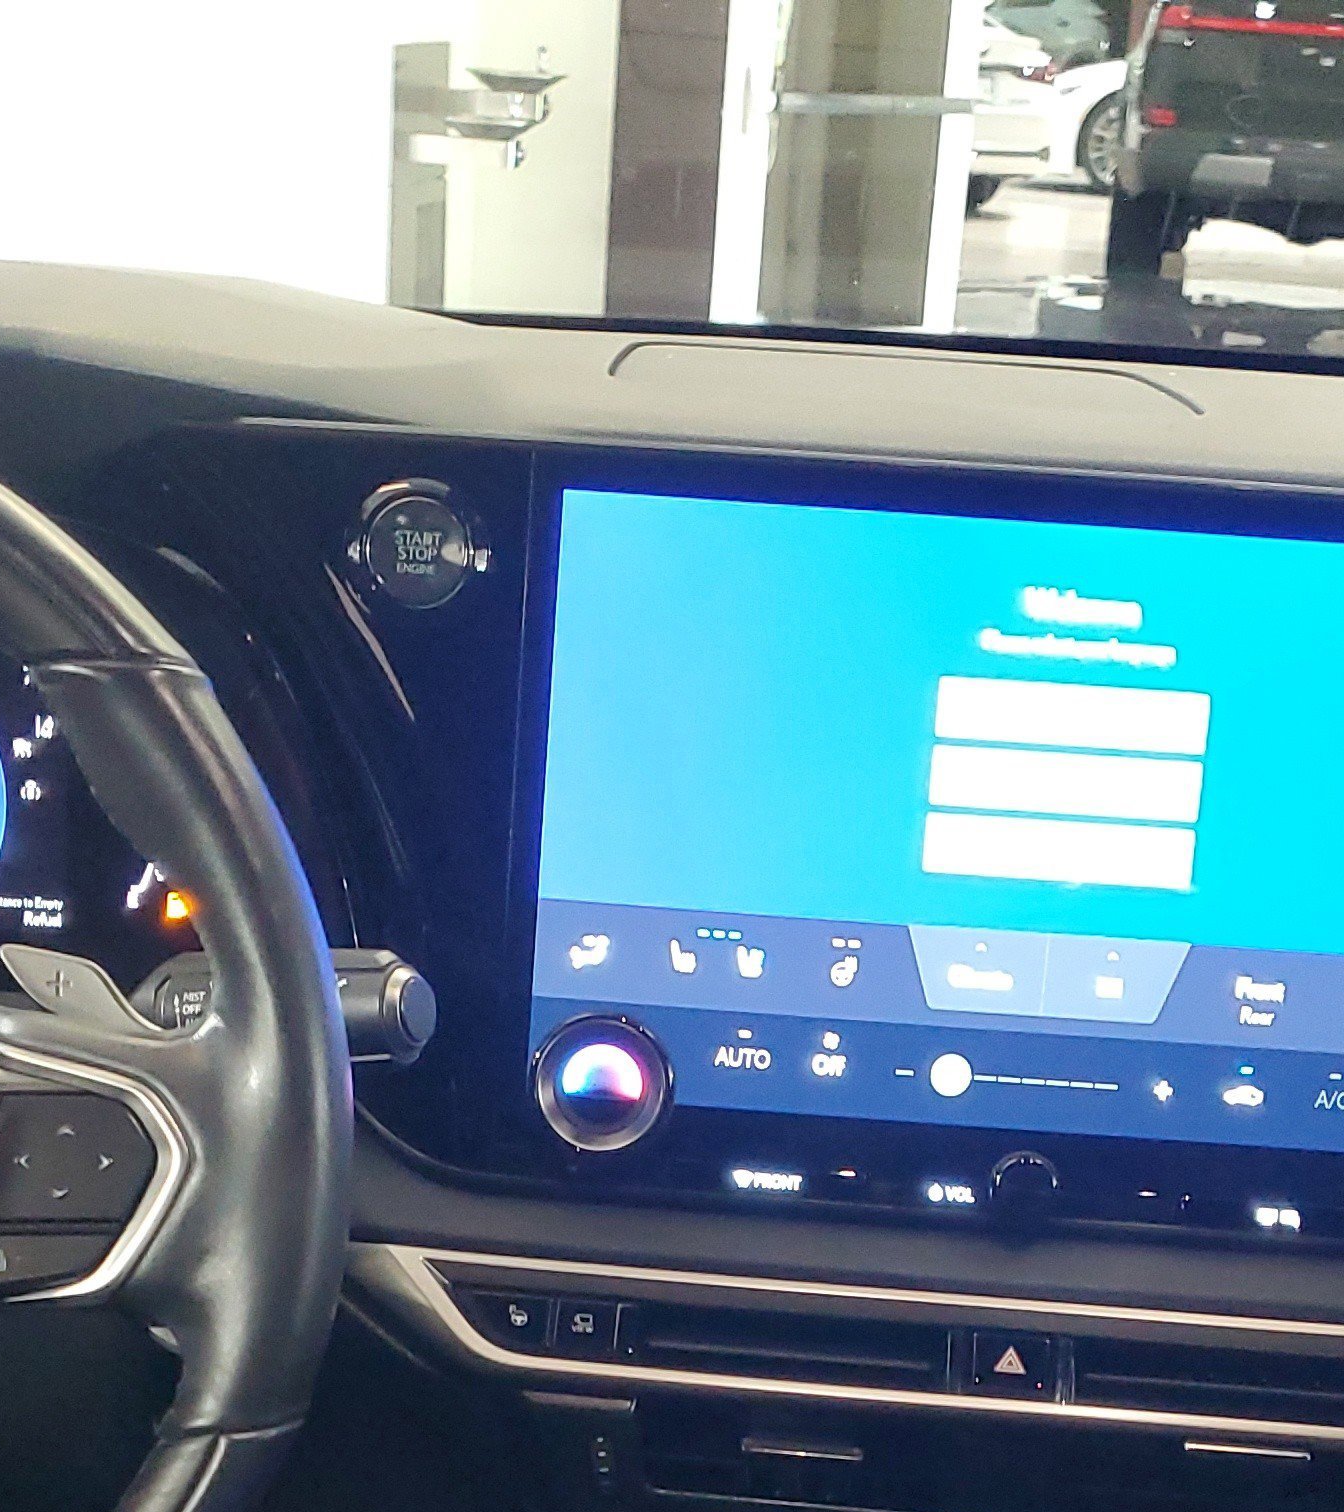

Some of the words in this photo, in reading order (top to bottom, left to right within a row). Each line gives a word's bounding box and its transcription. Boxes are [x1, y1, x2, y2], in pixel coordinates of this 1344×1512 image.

[394, 530, 442, 547] START
[397, 546, 437, 561] STOP
[34, 896, 63, 911] Empty
[22, 910, 63, 928] Refuel
[182, 991, 207, 1002] MIST
[182, 1003, 202, 1015] OFF
[1239, 1004, 1275, 1026] Rear
[714, 1046, 772, 1070] AUTO
[754, 1171, 803, 1191] FRONT
[944, 1184, 975, 1204] VOL
